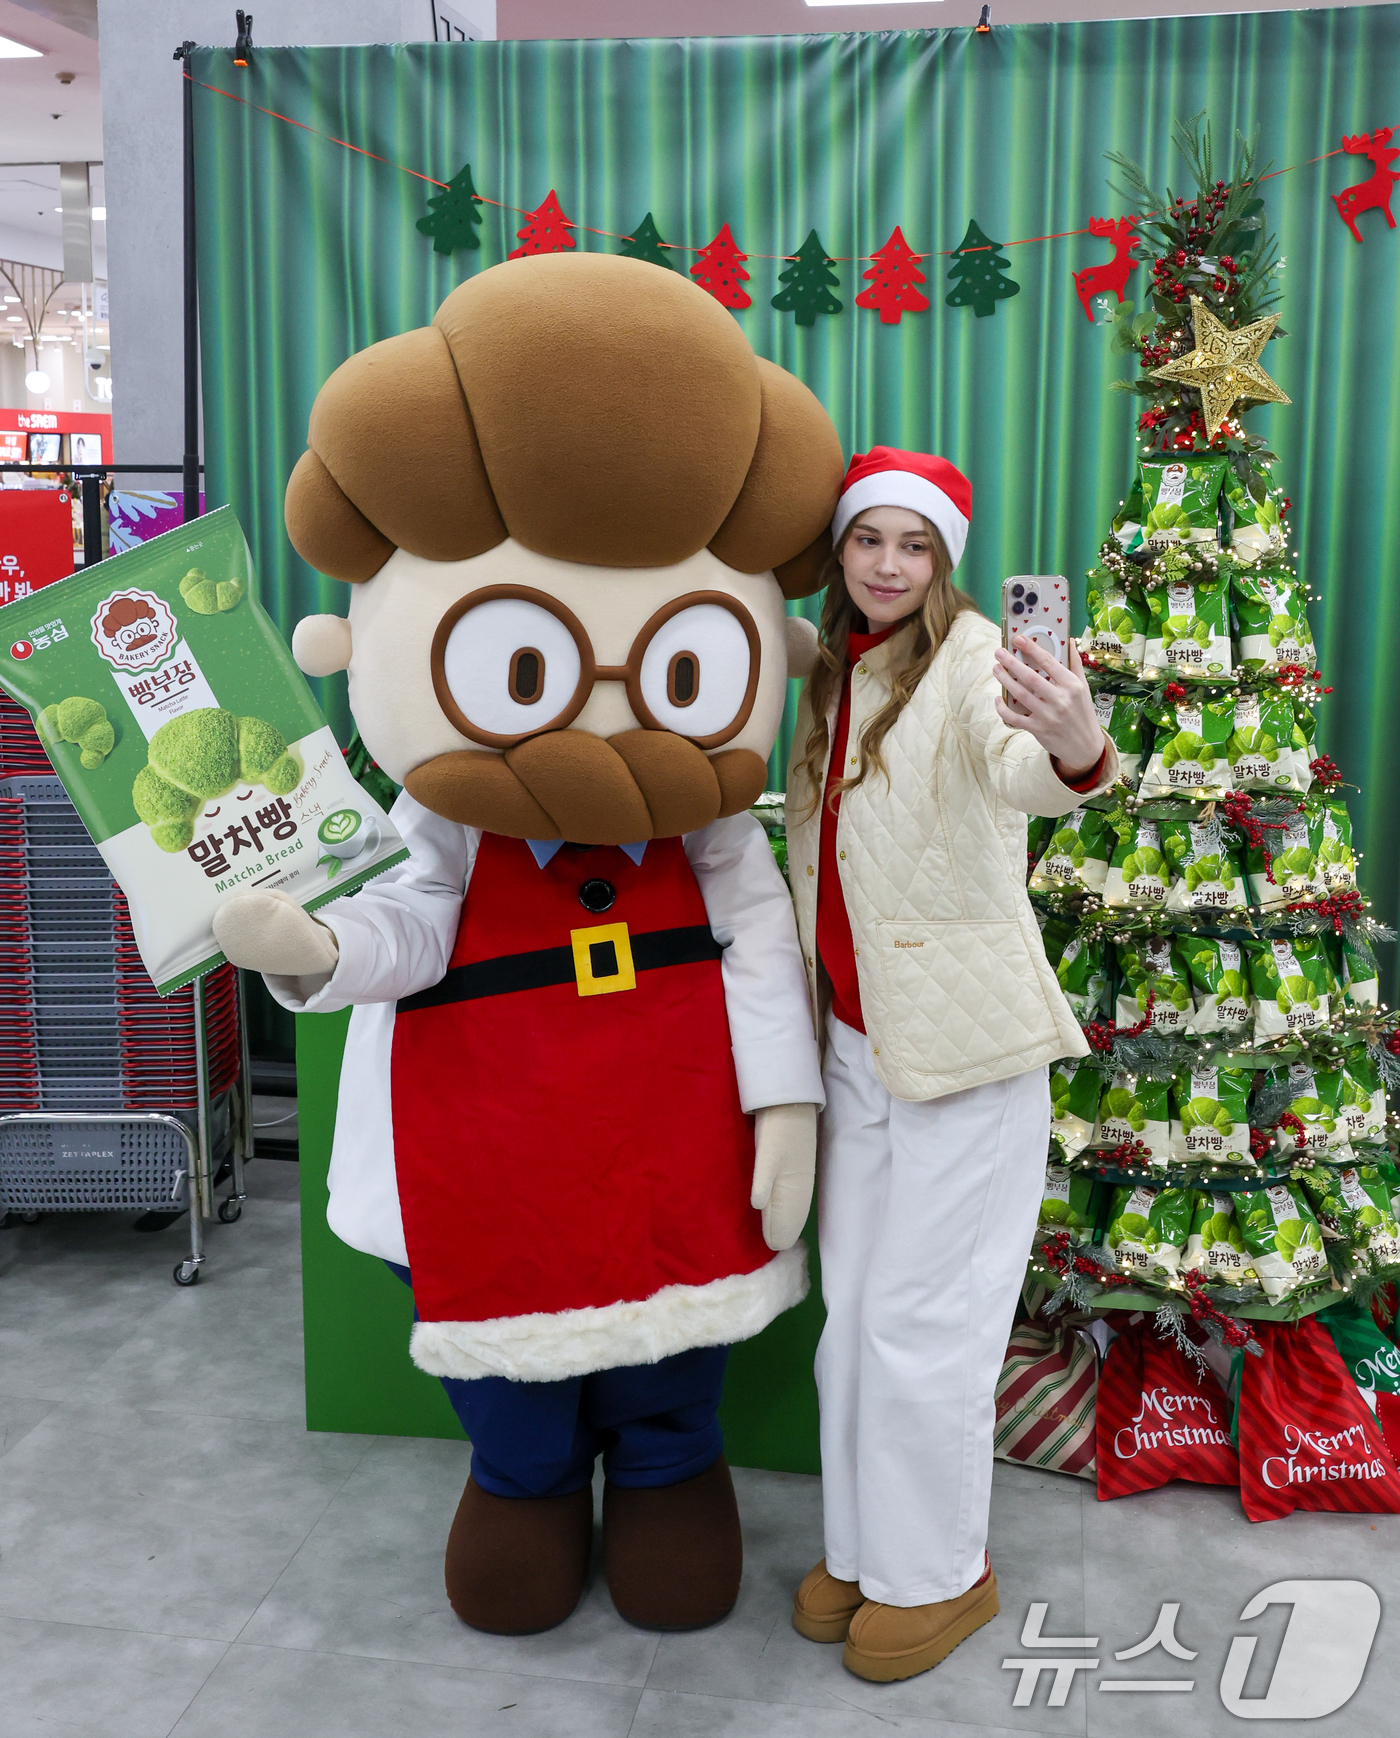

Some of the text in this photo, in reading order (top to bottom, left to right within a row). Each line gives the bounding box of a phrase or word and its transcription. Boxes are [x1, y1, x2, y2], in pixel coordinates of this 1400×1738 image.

[32, 624, 70, 650] 농심
[119, 631, 168, 661] BAKERY SNACK
[1165, 649, 1203, 663] 말차빵
[1276, 648, 1301, 662] 말차빵
[128, 660, 196, 705] 빵부장
[158, 694, 189, 713] Matcha Latte
[169, 704, 184, 715] Flavor
[1168, 769, 1205, 785] 말차빵
[1233, 763, 1271, 779] 말차빵
[301, 803, 325, 826] 스낵
[187, 797, 298, 878] 말차빵
[214, 838, 304, 893] Matcha Bread
[1045, 861, 1074, 881] 말차빵
[1128, 883, 1165, 900] 말차빵
[1192, 891, 1229, 905] 말차빵
[894, 940, 924, 949] Barbour
[1217, 1005, 1249, 1021] 말차빵
[1286, 1013, 1316, 1028] 말차빵
[1101, 1125, 1135, 1144] 말차빵
[1185, 1136, 1224, 1151] 말차빵
[1115, 1250, 1149, 1267] 말차빵
[1208, 1251, 1241, 1268] 말차빵
[1292, 1254, 1320, 1276] 말차빵
[1132, 1387, 1217, 1424] Merry
[1284, 1424, 1371, 1456] Merry
[1262, 1457, 1386, 1489] Christmas
